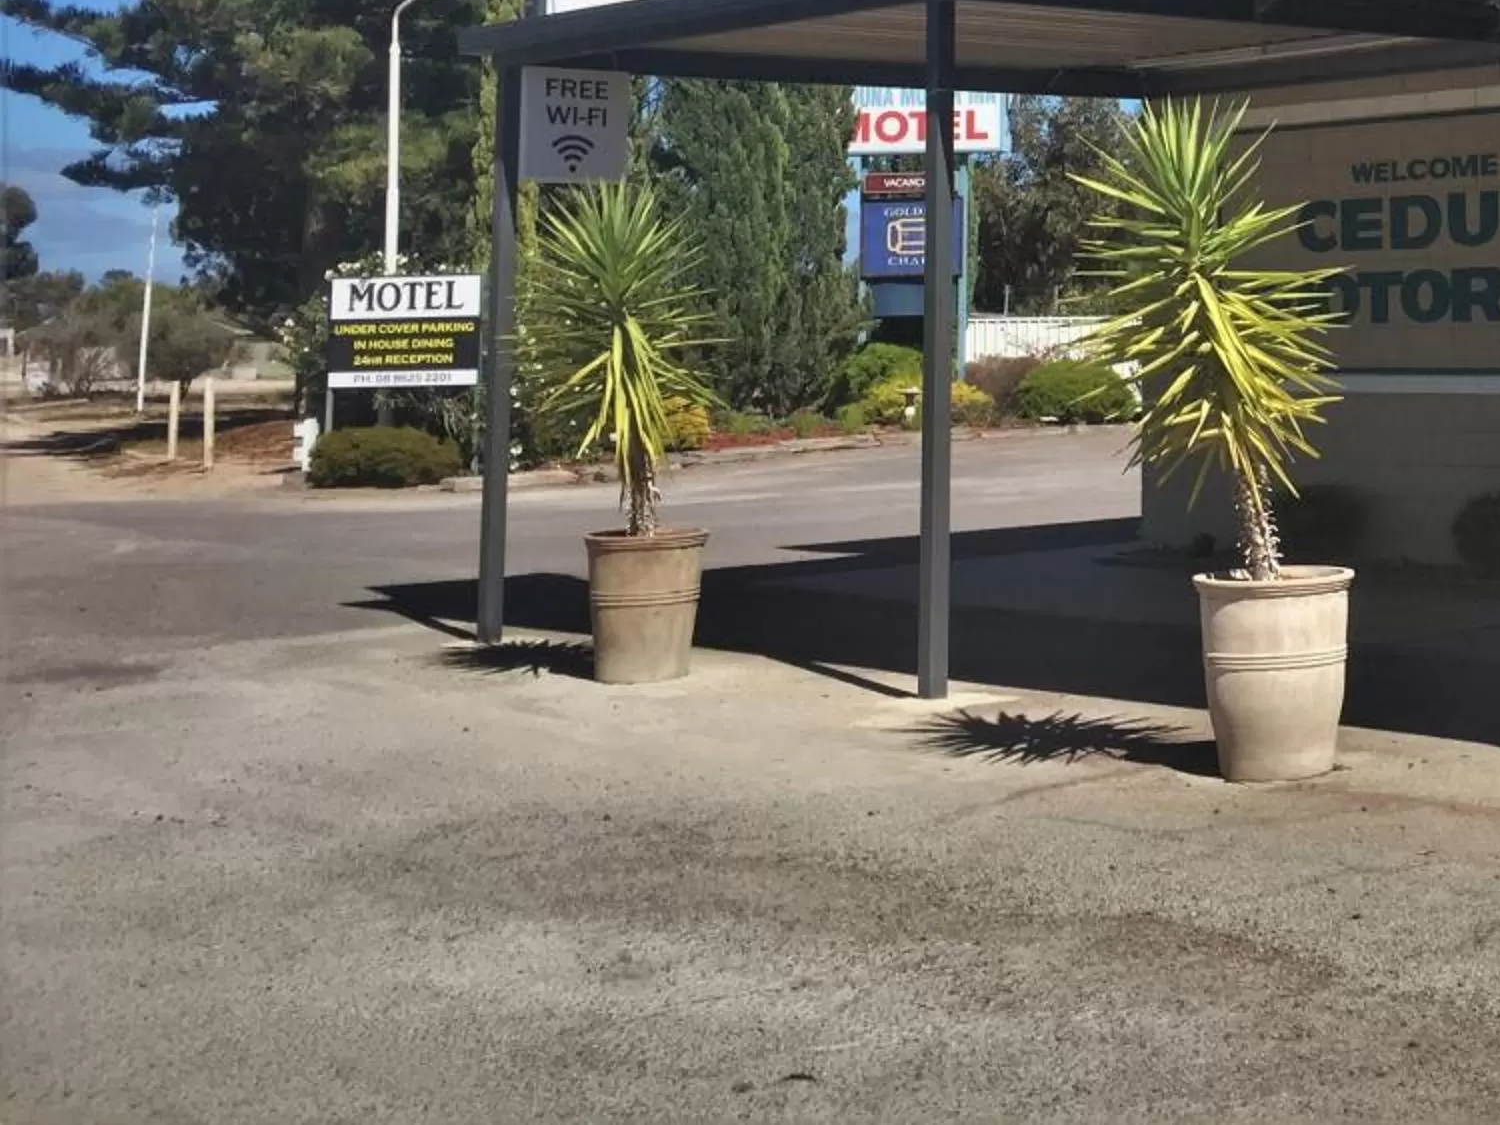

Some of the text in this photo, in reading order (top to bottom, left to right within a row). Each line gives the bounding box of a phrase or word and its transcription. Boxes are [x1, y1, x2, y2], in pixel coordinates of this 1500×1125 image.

[545, 79, 609, 100] FREE
[546, 105, 607, 127] WI-FI
[1351, 153, 1499, 184] WELCOME
[884, 178, 926, 188] VACANC
[349, 281, 463, 311] MOTEL
[334, 322, 475, 335] UNDER COVER PARKING
[353, 338, 454, 350] IN HOUSE DINING
[385, 353, 453, 364] RECEPTION
